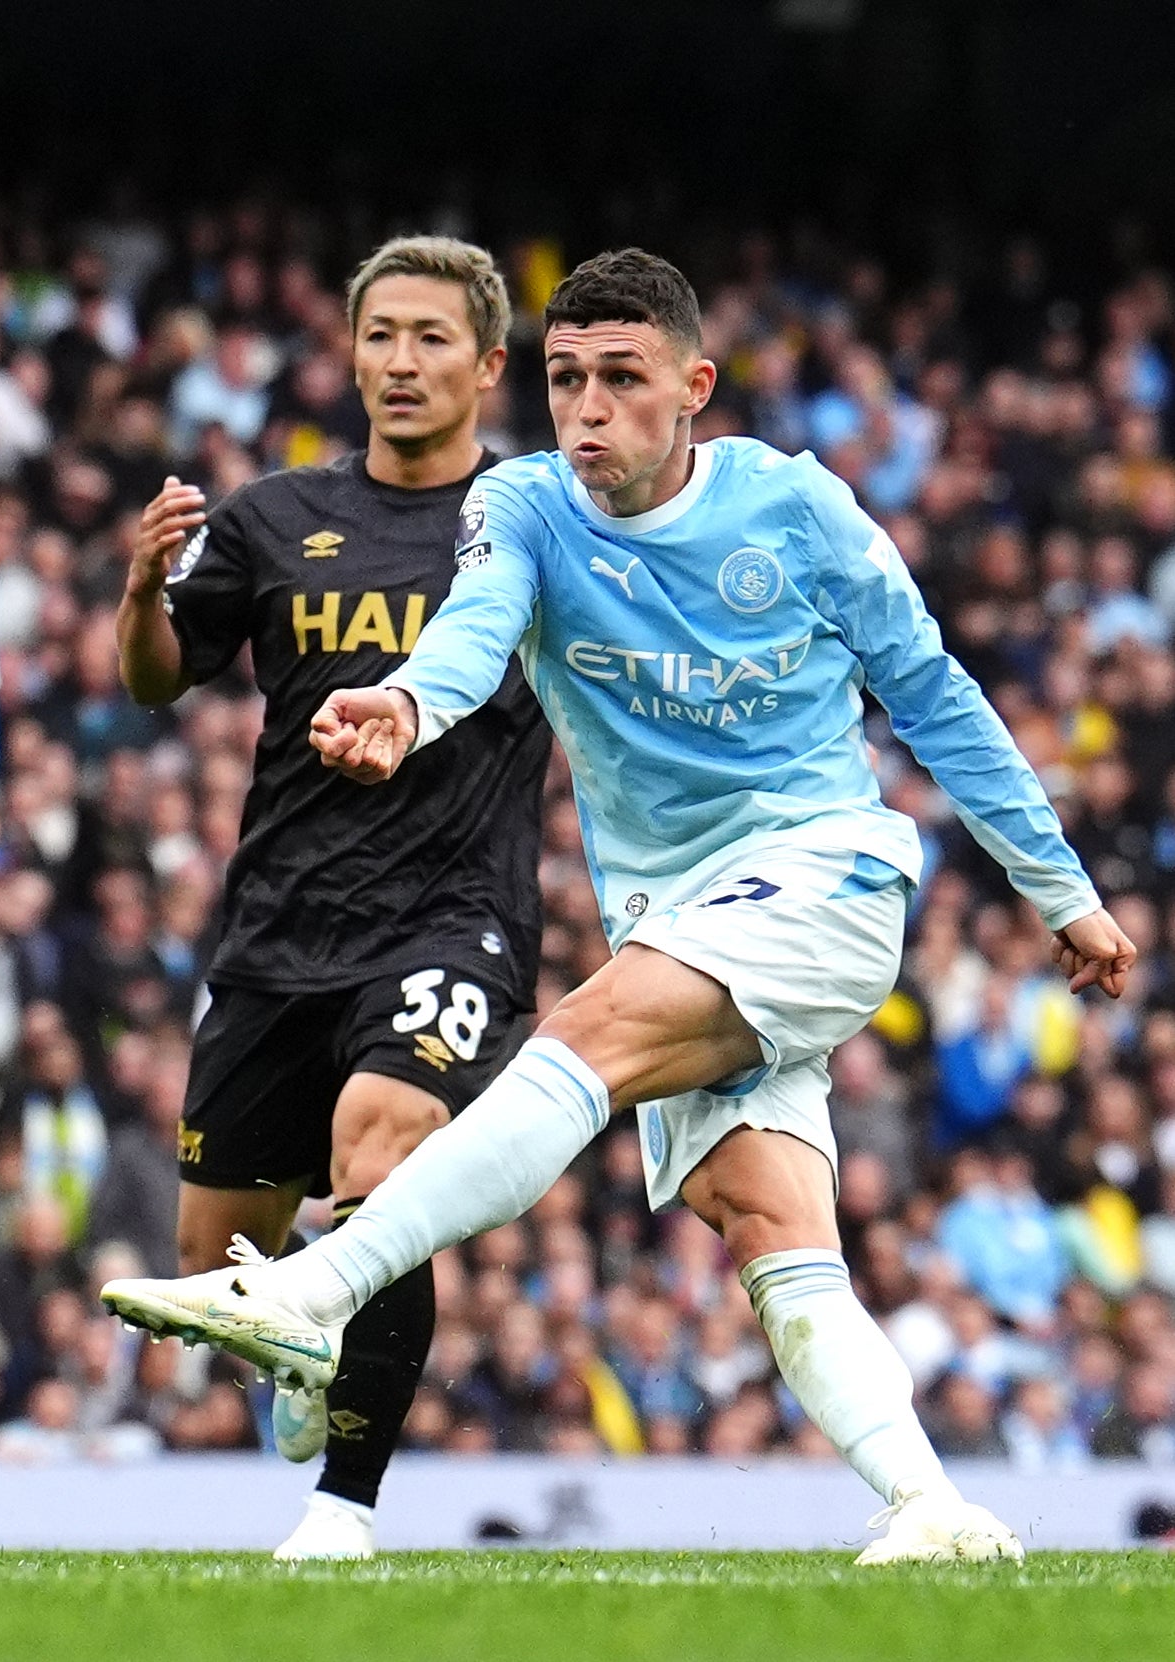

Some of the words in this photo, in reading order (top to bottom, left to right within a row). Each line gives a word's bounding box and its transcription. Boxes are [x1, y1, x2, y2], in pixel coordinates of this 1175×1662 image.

[565, 632, 813, 696] ETIHAD
[629, 693, 779, 728] AIRWAYS
[392, 968, 489, 1061] 38
